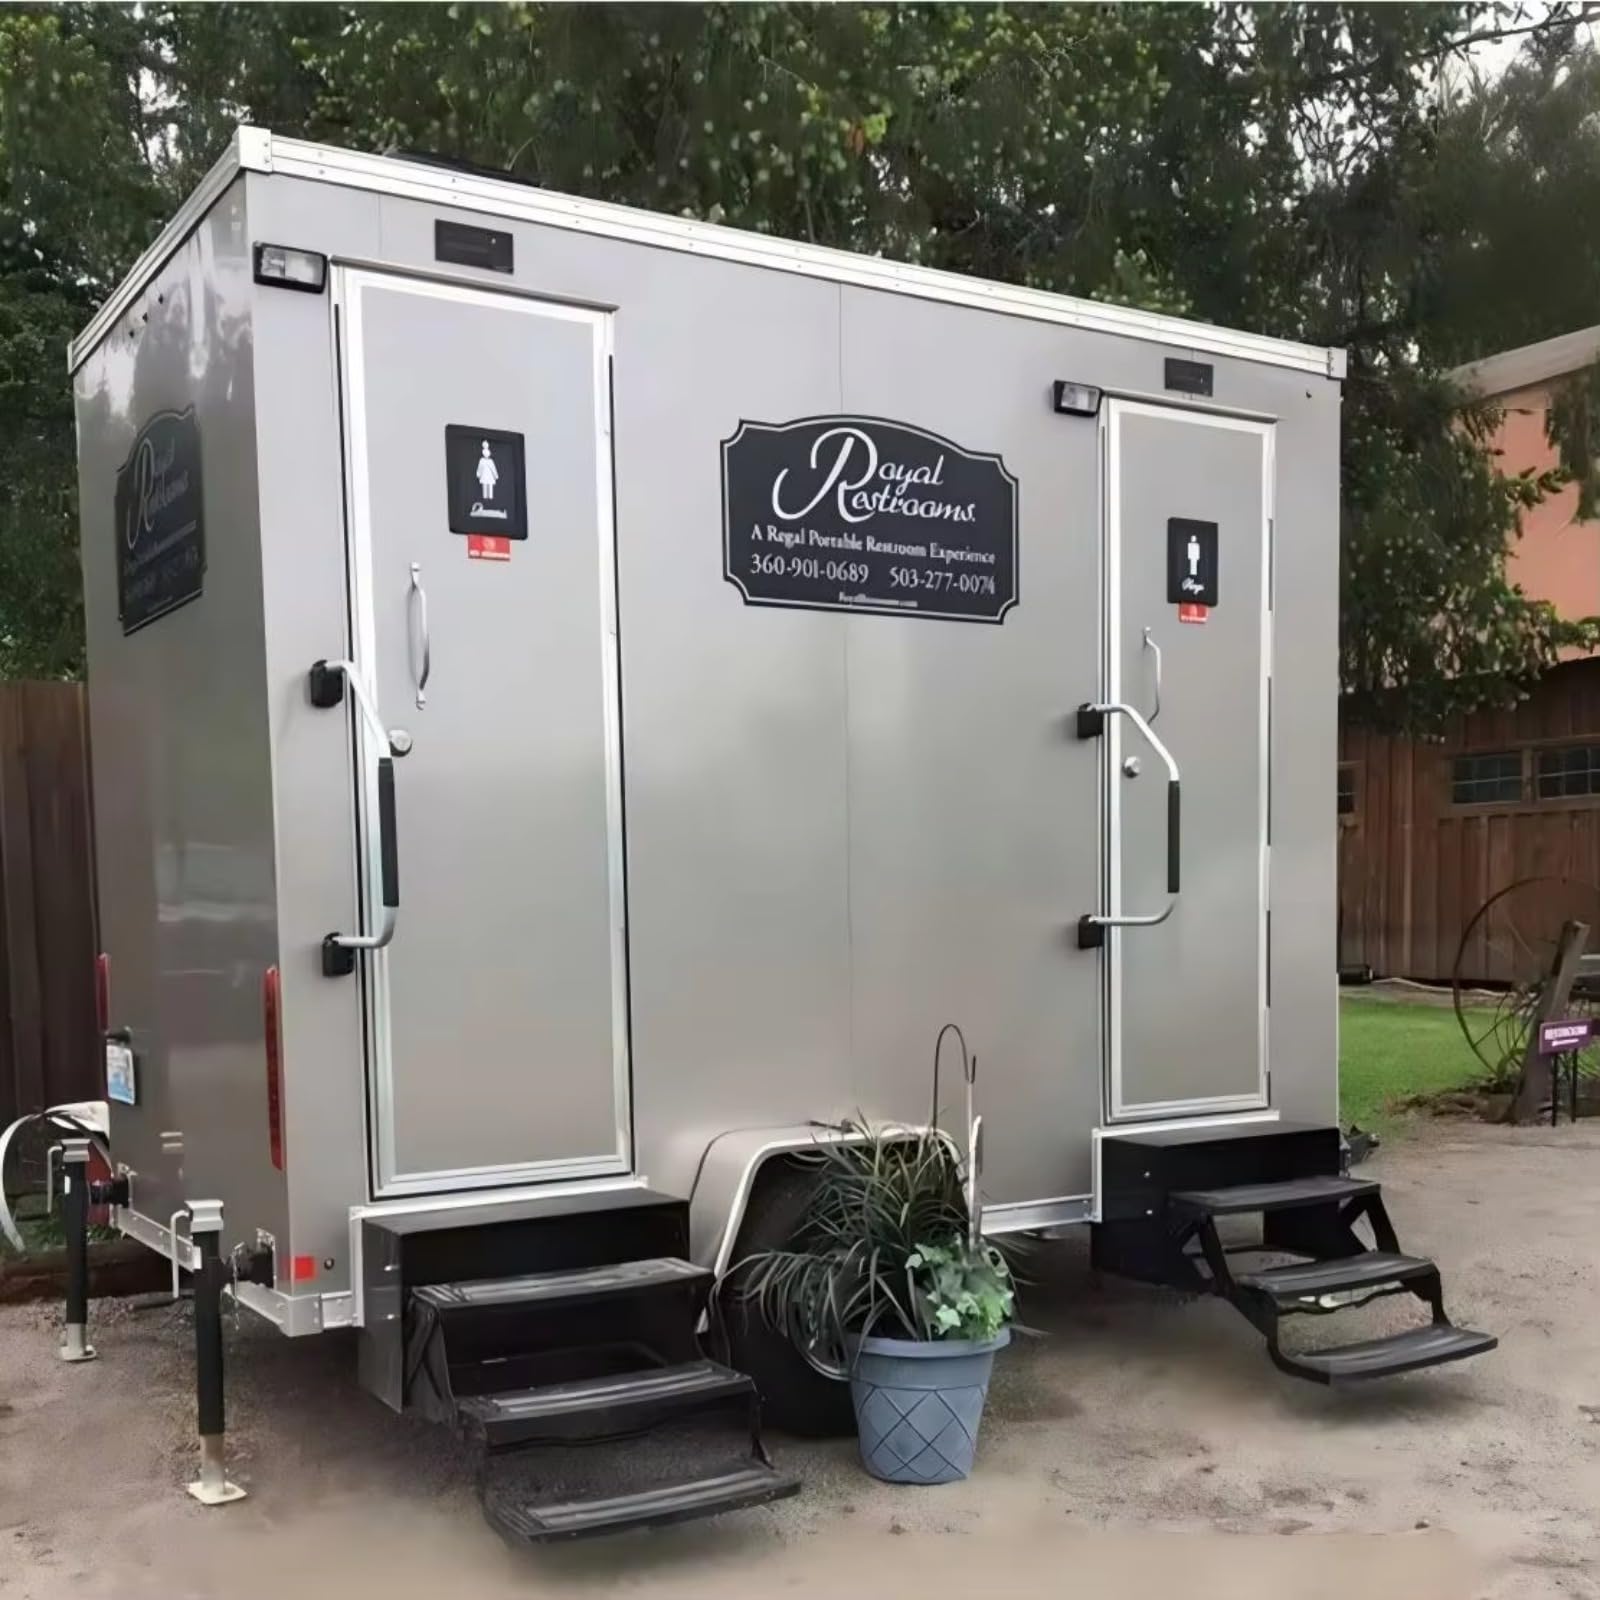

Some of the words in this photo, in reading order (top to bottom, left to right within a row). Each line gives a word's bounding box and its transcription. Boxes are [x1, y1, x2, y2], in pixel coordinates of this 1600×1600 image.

[772, 427, 944, 520] Royal
[751, 523, 763, 540] A
[766, 524, 805, 549] Regal
[808, 529, 863, 551] Portable
[866, 535, 927, 557] Restroom
[750, 553, 869, 583] 360-901-0689
